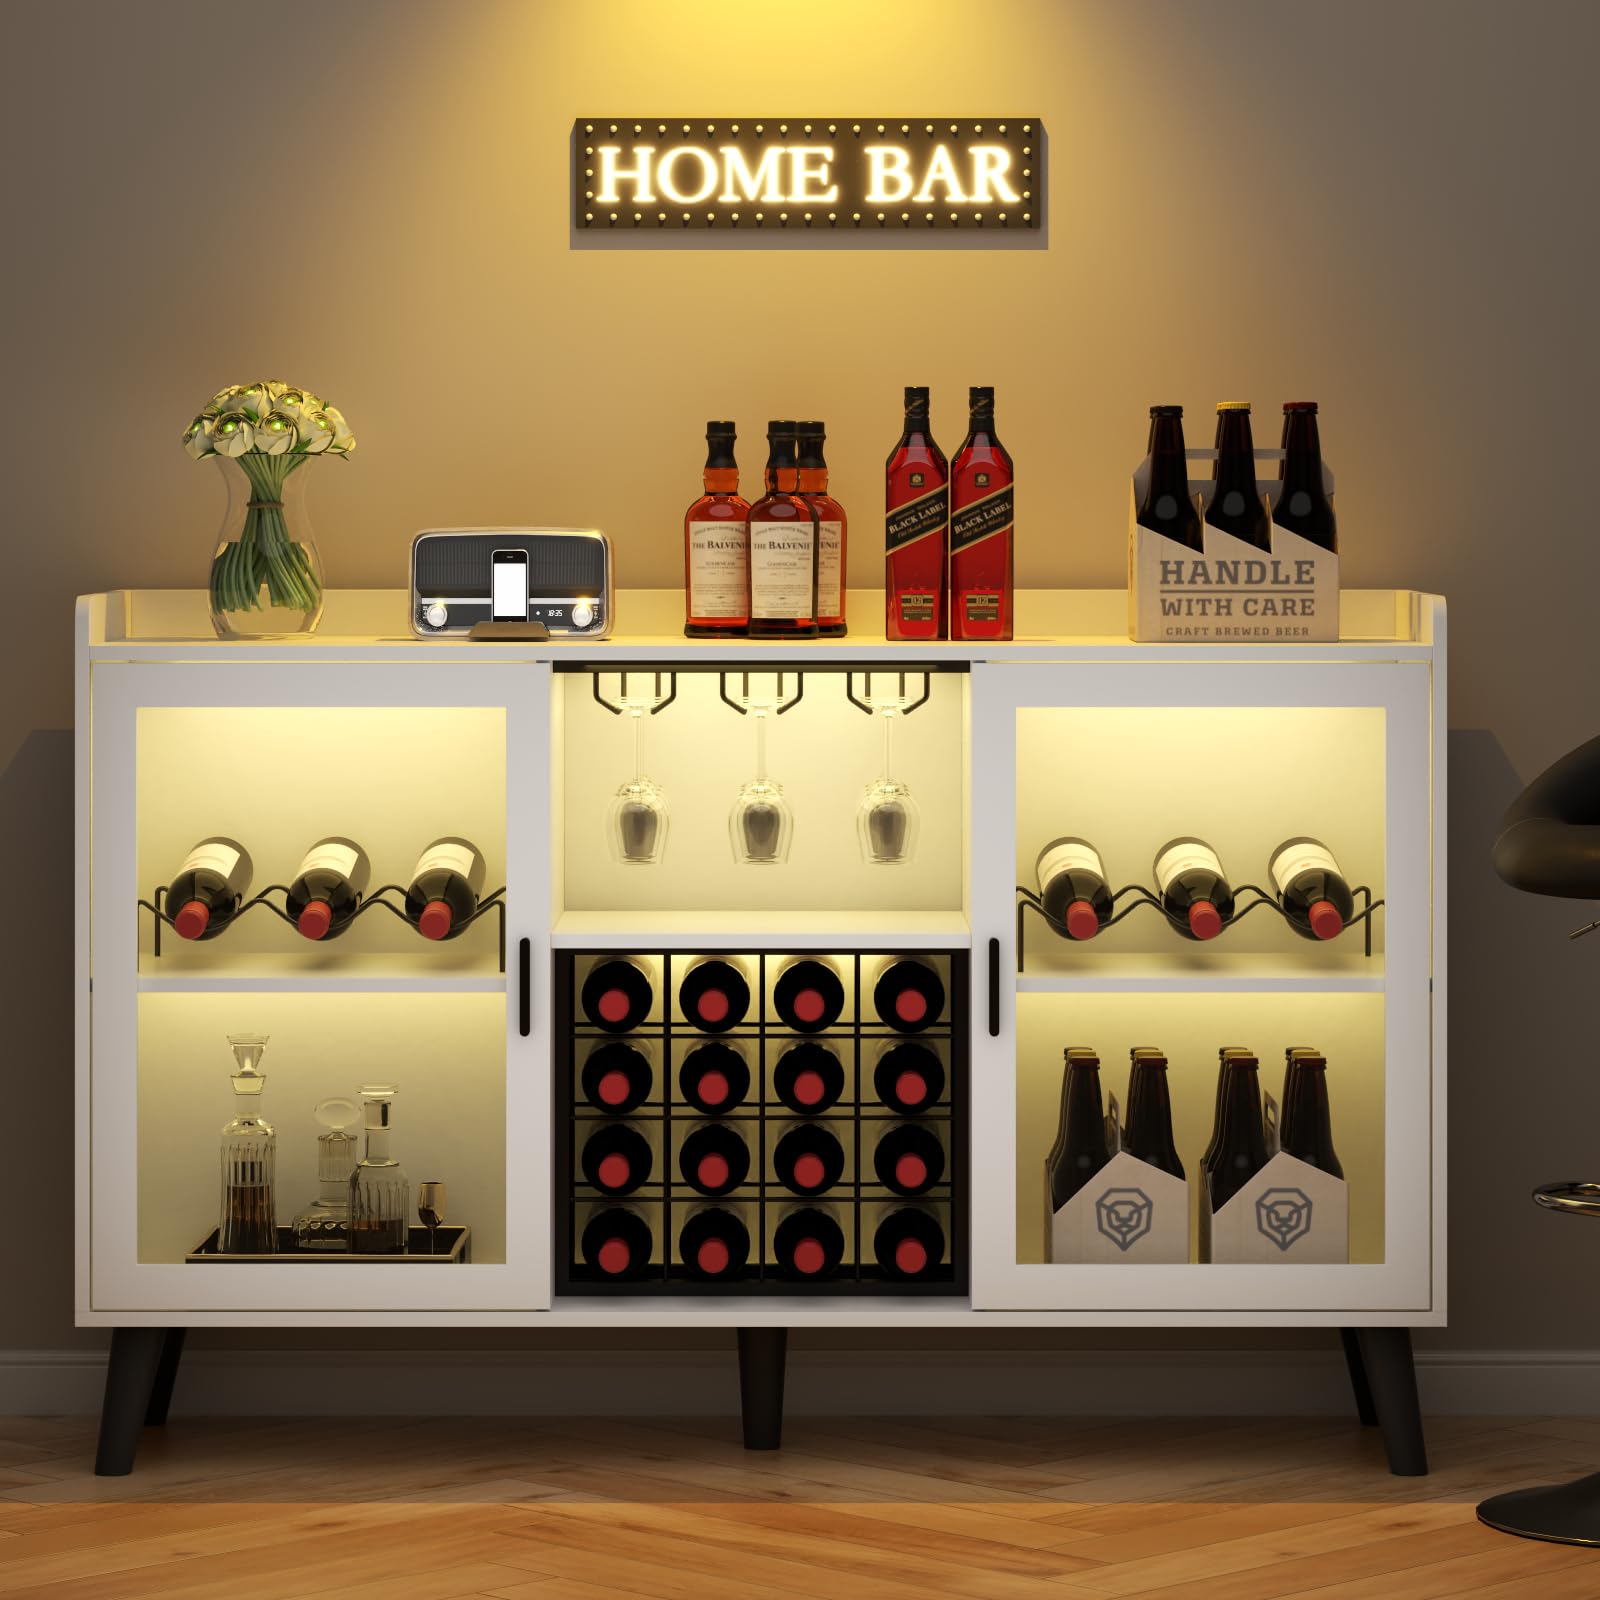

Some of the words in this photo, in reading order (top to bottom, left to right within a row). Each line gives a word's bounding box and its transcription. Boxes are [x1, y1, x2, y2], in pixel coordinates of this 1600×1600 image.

[596, 145, 838, 204] HOME
[864, 145, 1020, 204] BAR
[889, 515, 918, 534] BLACK
[918, 502, 946, 520] LABEL
[954, 515, 983, 534] BLACK
[983, 502, 1011, 520] LABEL
[1159, 560, 1315, 585] HANDLE
[1159, 598, 1233, 617] WITH
[1243, 598, 1315, 617] CARE
[1166, 627, 1209, 636] CRAFT
[1215, 627, 1270, 636] BREWED
[1275, 627, 1309, 636] BEER
